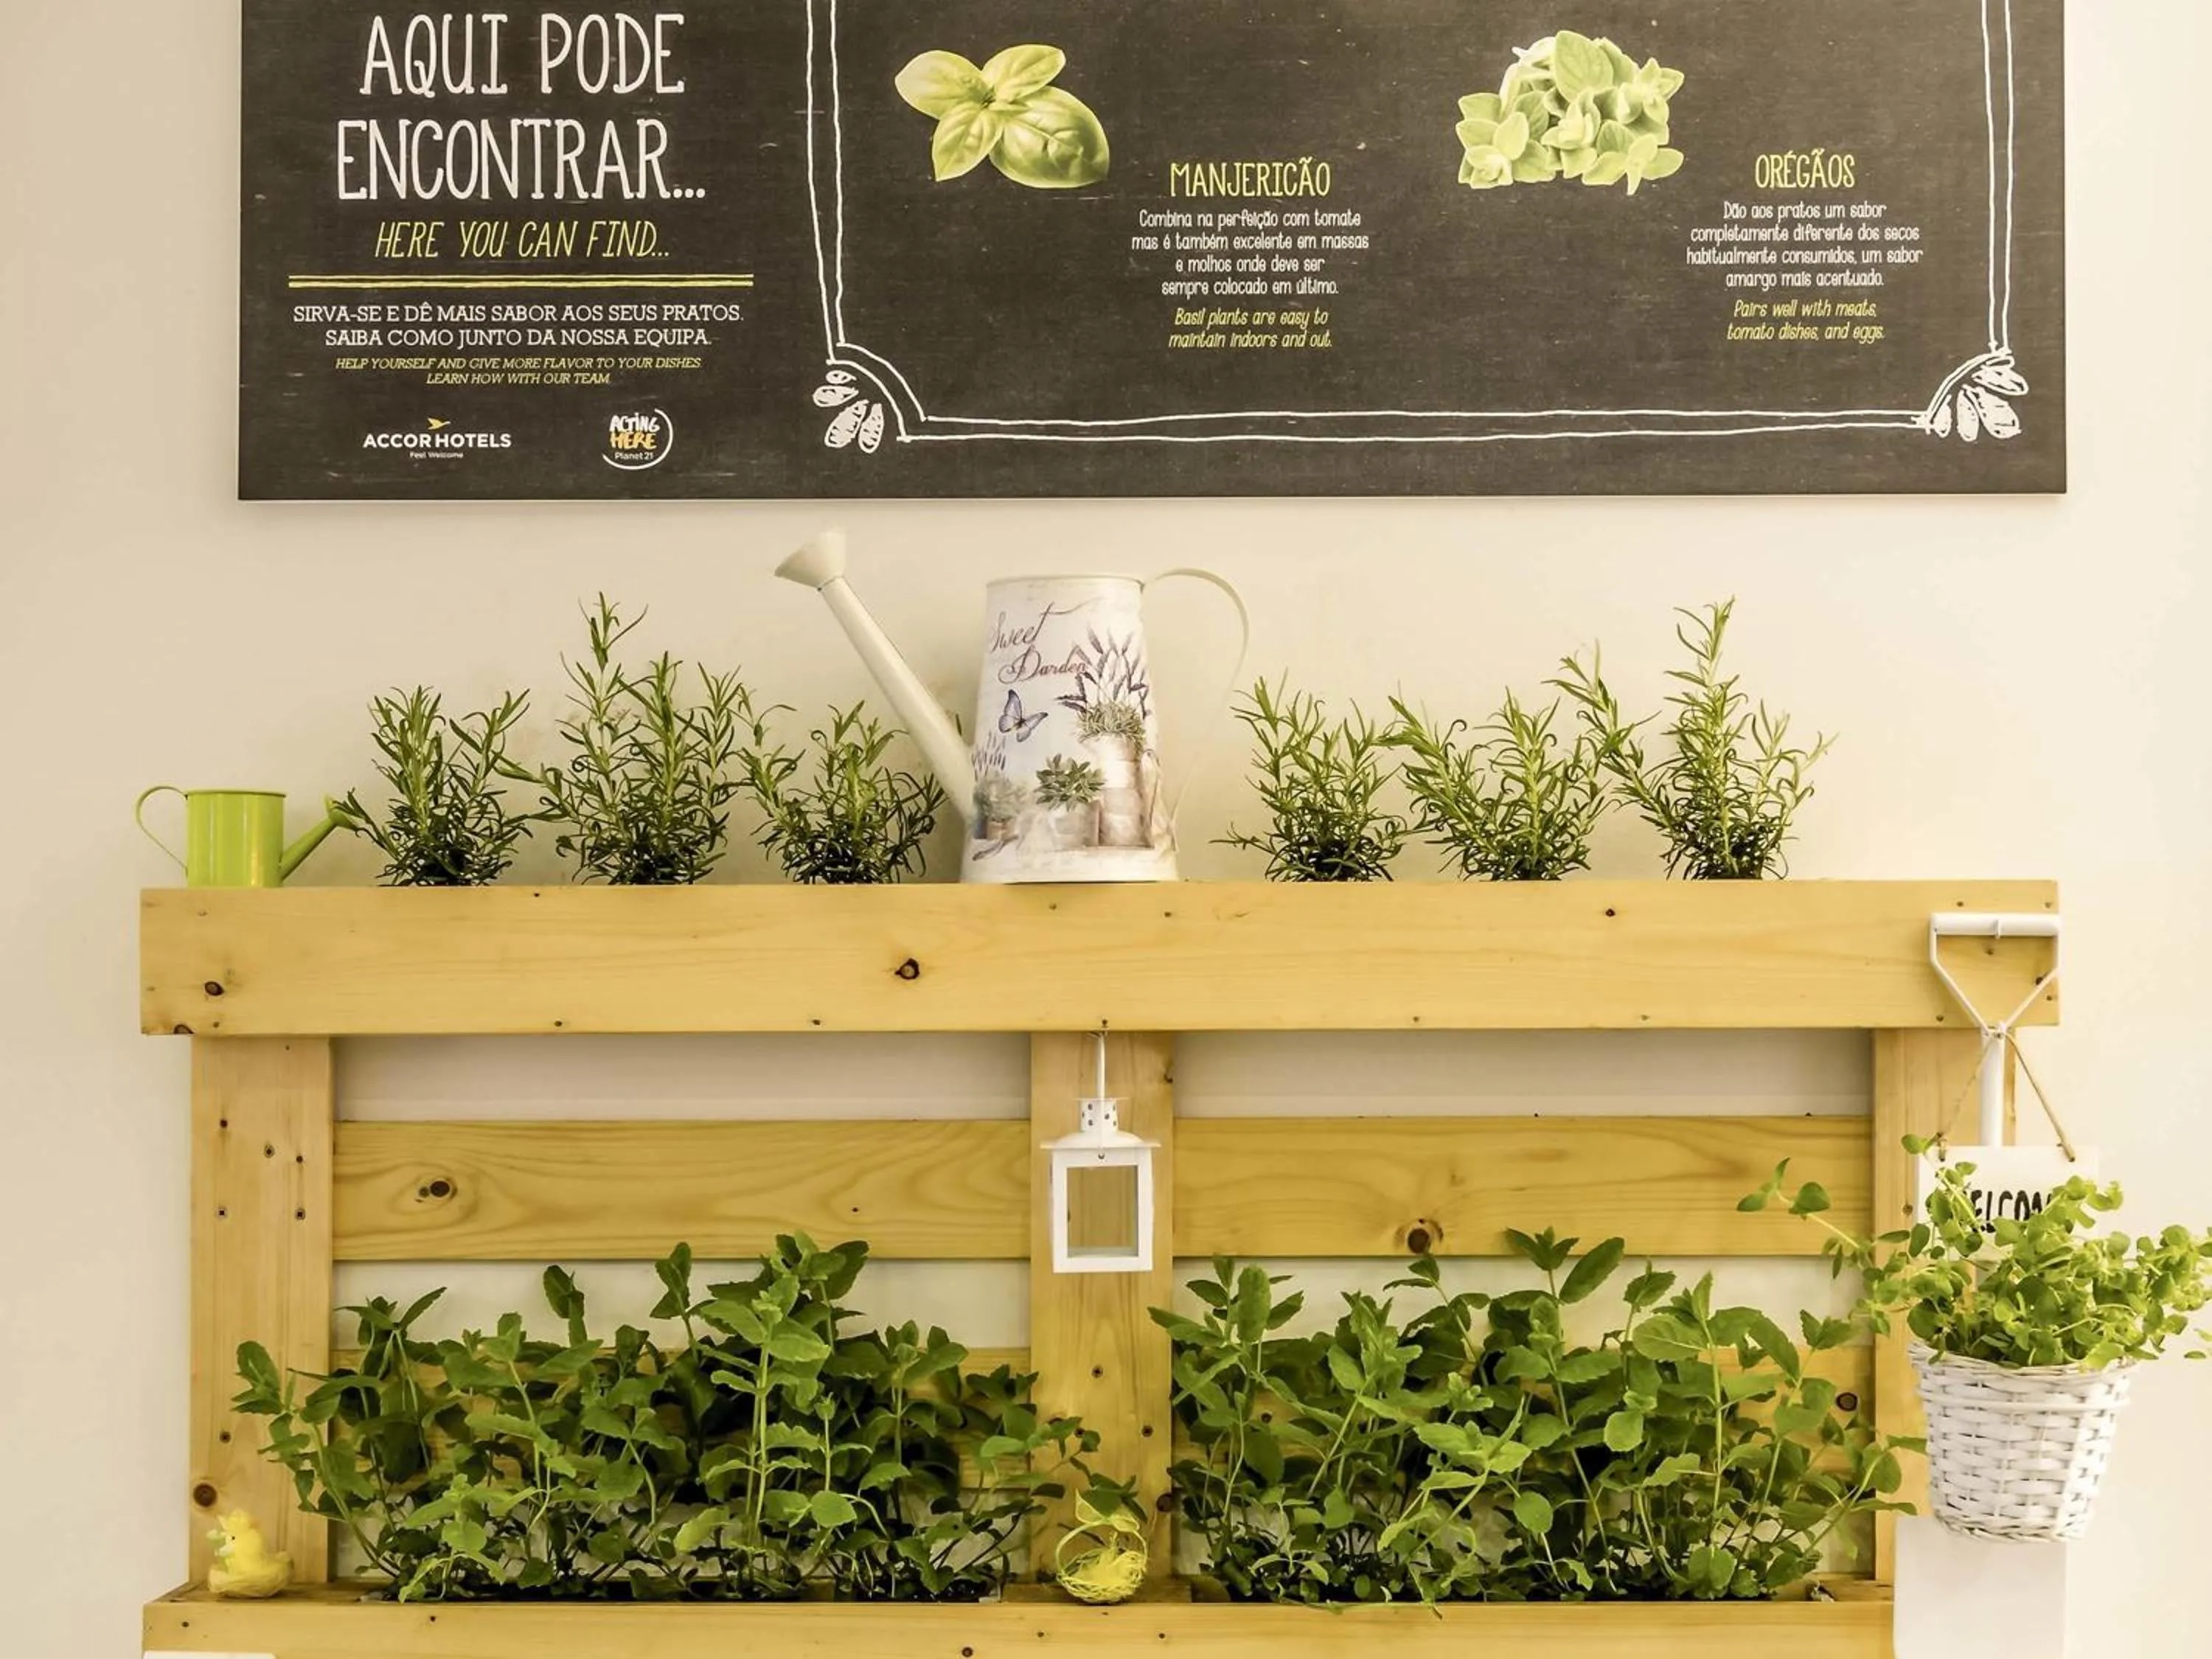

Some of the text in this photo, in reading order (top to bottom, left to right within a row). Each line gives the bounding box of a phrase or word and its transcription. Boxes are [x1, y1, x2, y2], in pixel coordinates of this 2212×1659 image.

[360, 13, 685, 97] AQUI PODE
[337, 118, 706, 201] ENCONTRAR...
[1755, 148, 1856, 188] ORÉGÃOS
[1169, 156, 1331, 197] MANJERICÃO
[1139, 208, 1361, 232] Combina na perfeição com tomate
[1723, 201, 1887, 223] Dão aos pratos um sabor
[375, 220, 670, 258] HERE YOU CAN FIND...
[1131, 232, 1369, 250] mas é também excelente em massas
[1690, 223, 1920, 246] completamente diferente dos secos
[1175, 254, 1325, 272] e molhos onde deve ser
[1686, 246, 1923, 265] habitualmente consumidos, um sabor
[1161, 277, 1339, 299] sempre colocado em último.
[1726, 268, 1884, 291] amargo mais acentuado.
[293, 302, 745, 323] SIRVA-SE E DÊ MAIS SABOR AOS SEUS PRATOS.
[1174, 307, 1329, 330] Basil plants are easy to
[1733, 299, 1877, 318] Pairs well with meats,
[325, 329, 712, 350] SAIBA COMO JUNTO DA NOSSA EQUIPA.
[1169, 331, 1333, 349] maintain indoors and out.
[1727, 322, 1886, 344] tomato dishes, and eggs.
[335, 358, 369, 369] HELP
[371, 358, 436, 369] YOURSELF
[437, 358, 467, 369] AND
[469, 357, 501, 369] GIVE
[504, 357, 541, 369] MORE
[543, 357, 596, 369] FLAVOR
[599, 357, 616, 369] TO
[619, 357, 654, 369] YOUR
[426, 374, 470, 384] LEARN
[472, 374, 505, 384] HOW
[507, 374, 540, 384] WITH
[543, 373, 572, 384] OUR
[363, 433, 512, 448] ACCOR HOTELS
[610, 432, 657, 450] HERE
